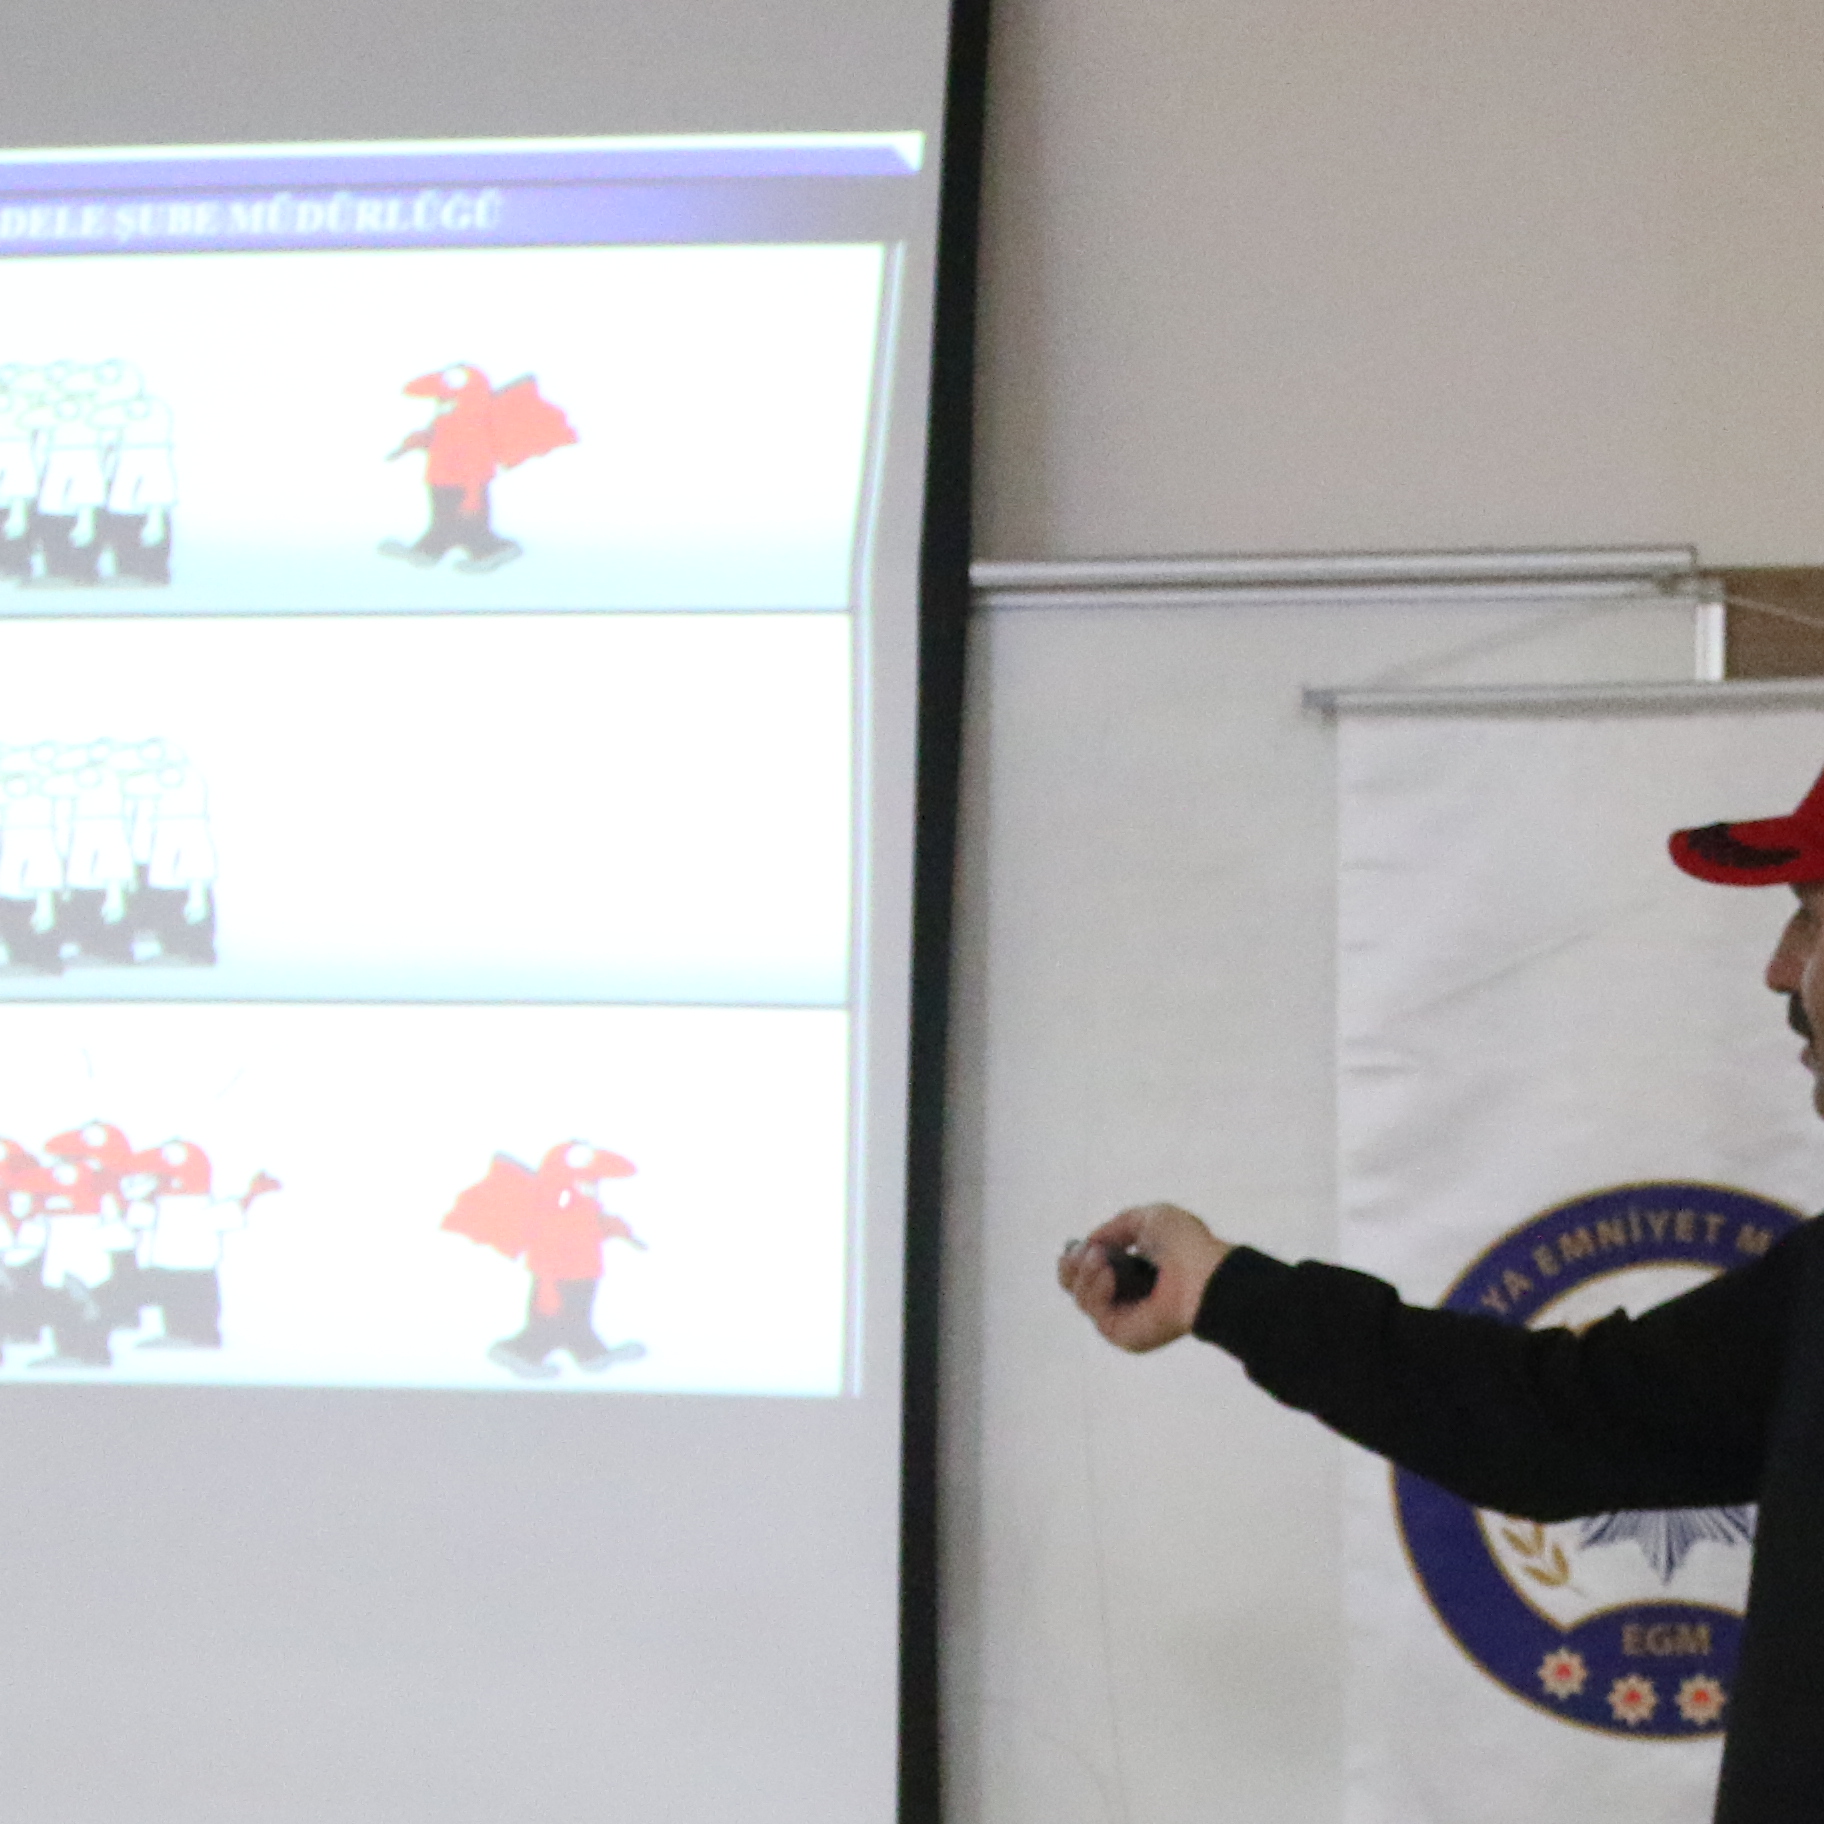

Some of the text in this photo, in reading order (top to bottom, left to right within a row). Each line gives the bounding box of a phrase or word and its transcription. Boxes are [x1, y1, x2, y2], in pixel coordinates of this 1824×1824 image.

[116, 202, 222, 242] ŞUBE
[1532, 1206, 1727, 1278] EMNİYET
[1621, 1621, 1712, 1657] EGM
